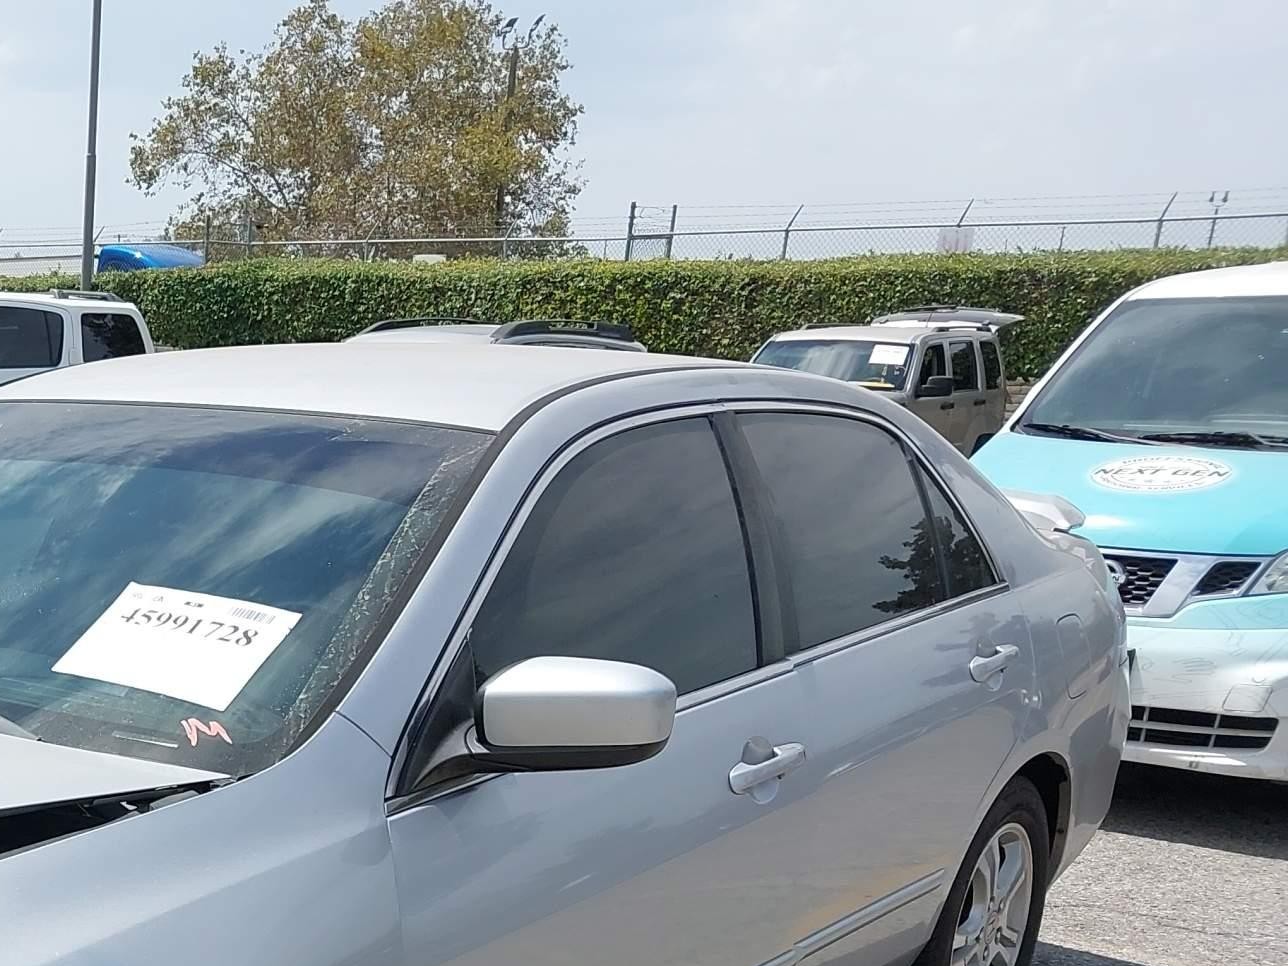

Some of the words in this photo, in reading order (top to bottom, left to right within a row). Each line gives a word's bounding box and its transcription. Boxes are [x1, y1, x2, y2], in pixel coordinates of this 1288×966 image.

[1093, 467, 1169, 476] NEXT
[1171, 468, 1230, 478] GEN
[120, 607, 259, 647] 45991728
